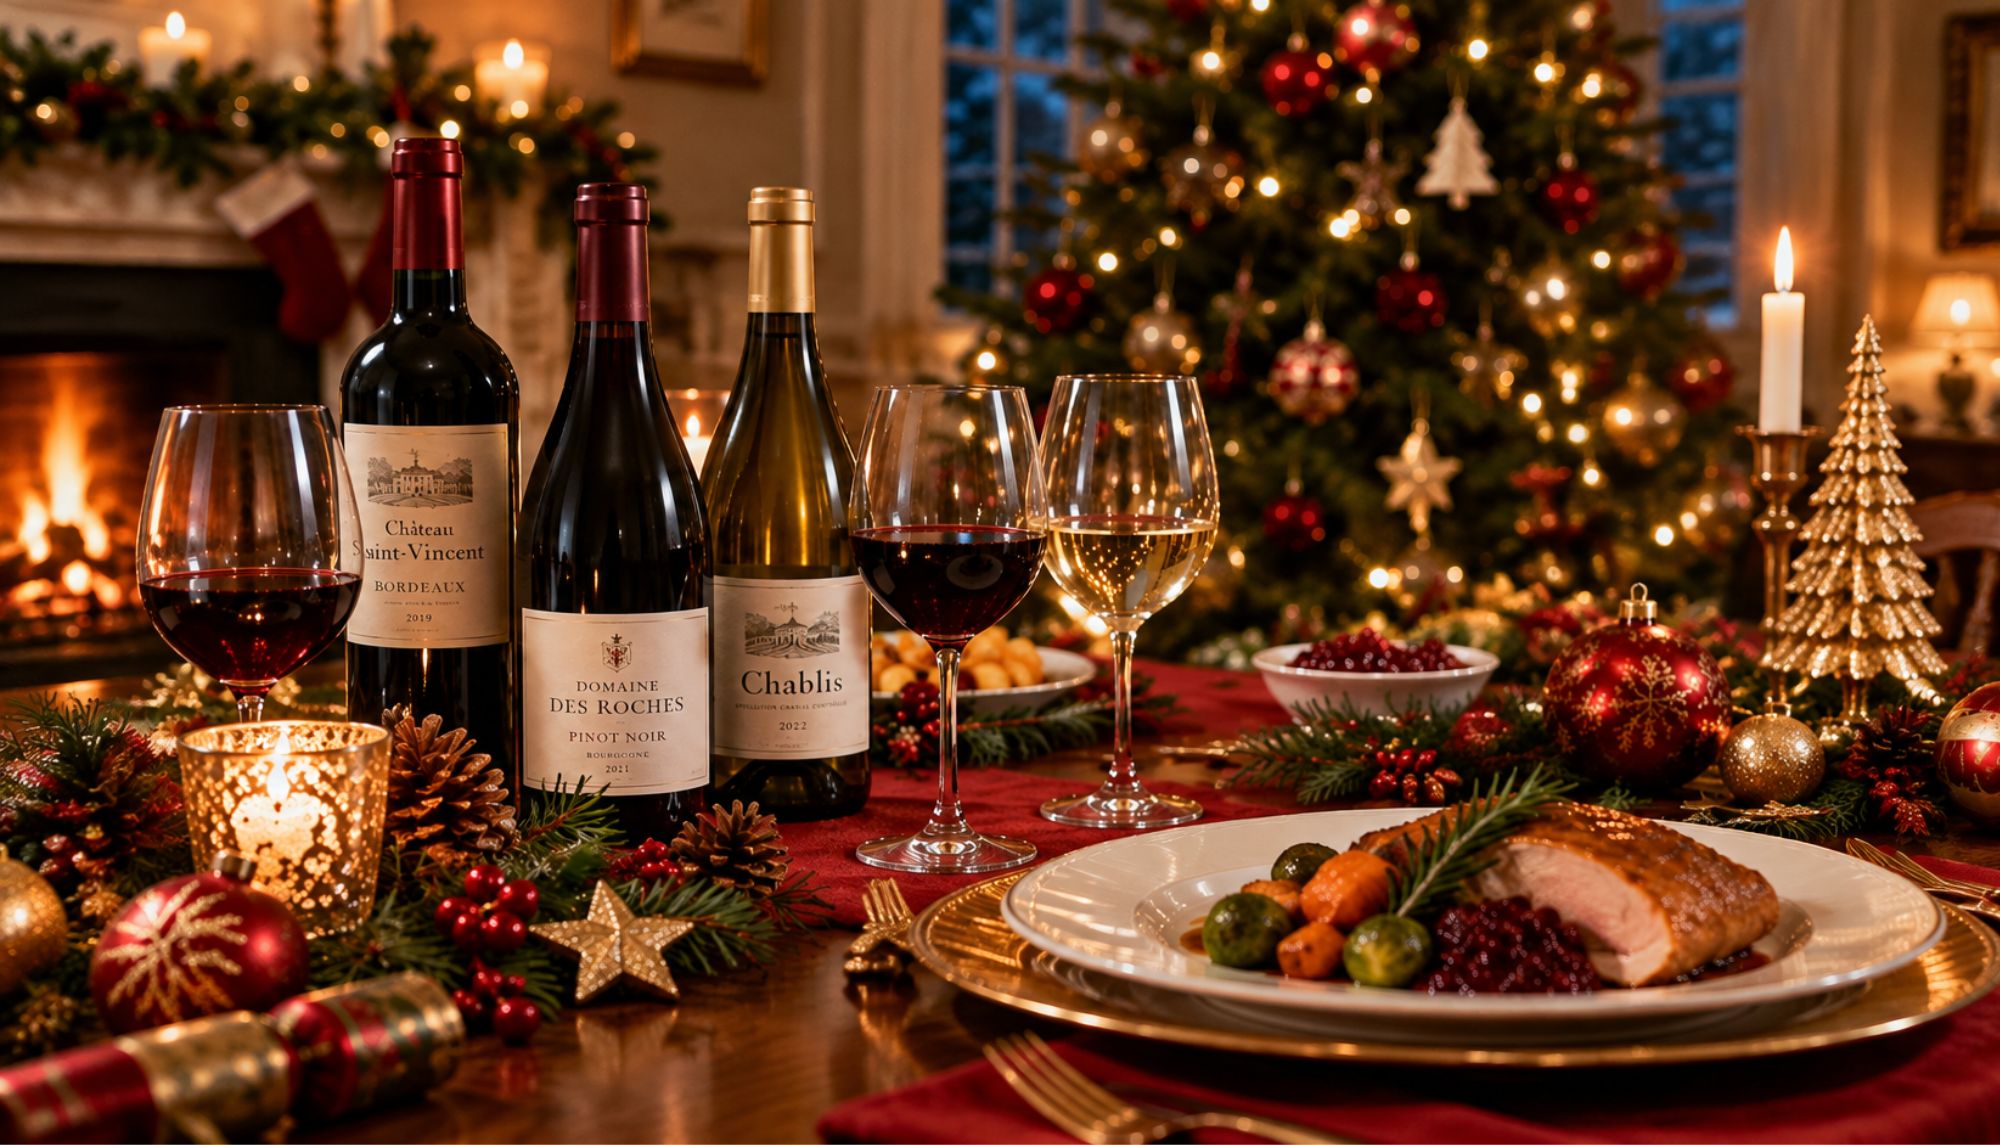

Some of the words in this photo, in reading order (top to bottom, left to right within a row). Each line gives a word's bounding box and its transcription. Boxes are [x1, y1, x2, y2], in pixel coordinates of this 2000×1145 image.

[375, 580, 465, 593] BORDEAUX
[406, 613, 433, 623] 2019
[577, 680, 659, 693] DOMAINE
[741, 669, 842, 695] Chablis
[550, 697, 588, 714] DES
[598, 696, 684, 715] ROCHES
[780, 721, 807, 731] 2022
[569, 731, 619, 743] PINOT
[626, 731, 666, 743] NOIR
[605, 764, 629, 773] 2021
